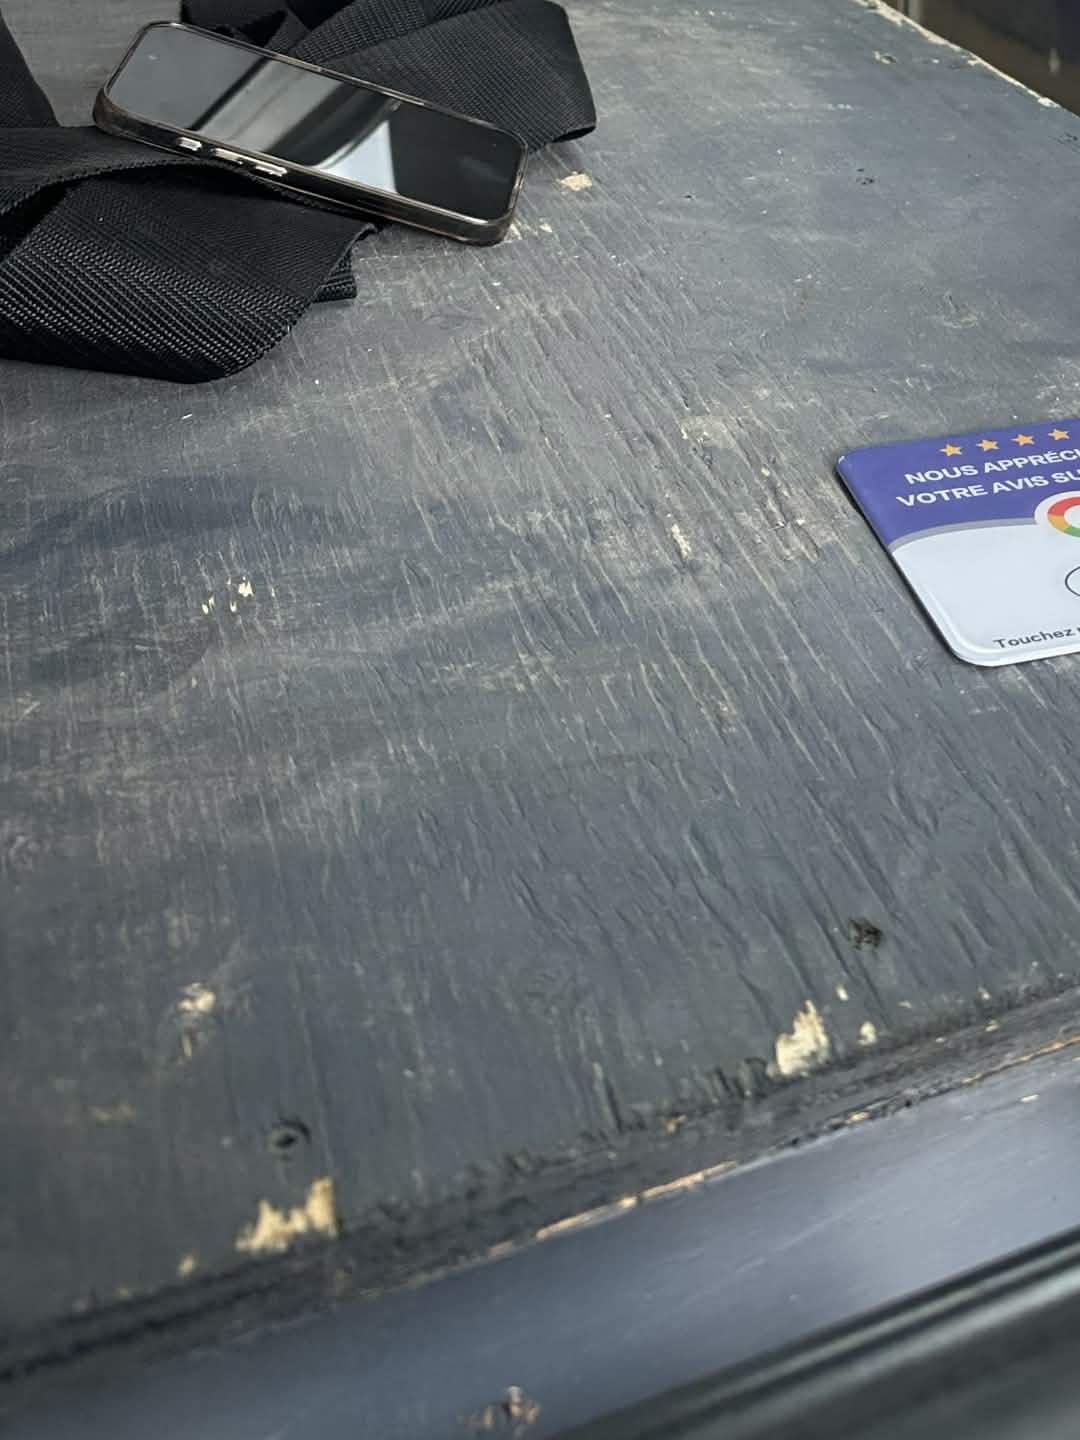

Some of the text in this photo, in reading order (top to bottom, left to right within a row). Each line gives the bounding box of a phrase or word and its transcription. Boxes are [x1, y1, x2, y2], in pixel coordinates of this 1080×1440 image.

[904, 464, 979, 485] NOUS
[896, 484, 988, 508] VOTRE
[992, 474, 1049, 494] AVIS
[993, 626, 1074, 649] Touchez
